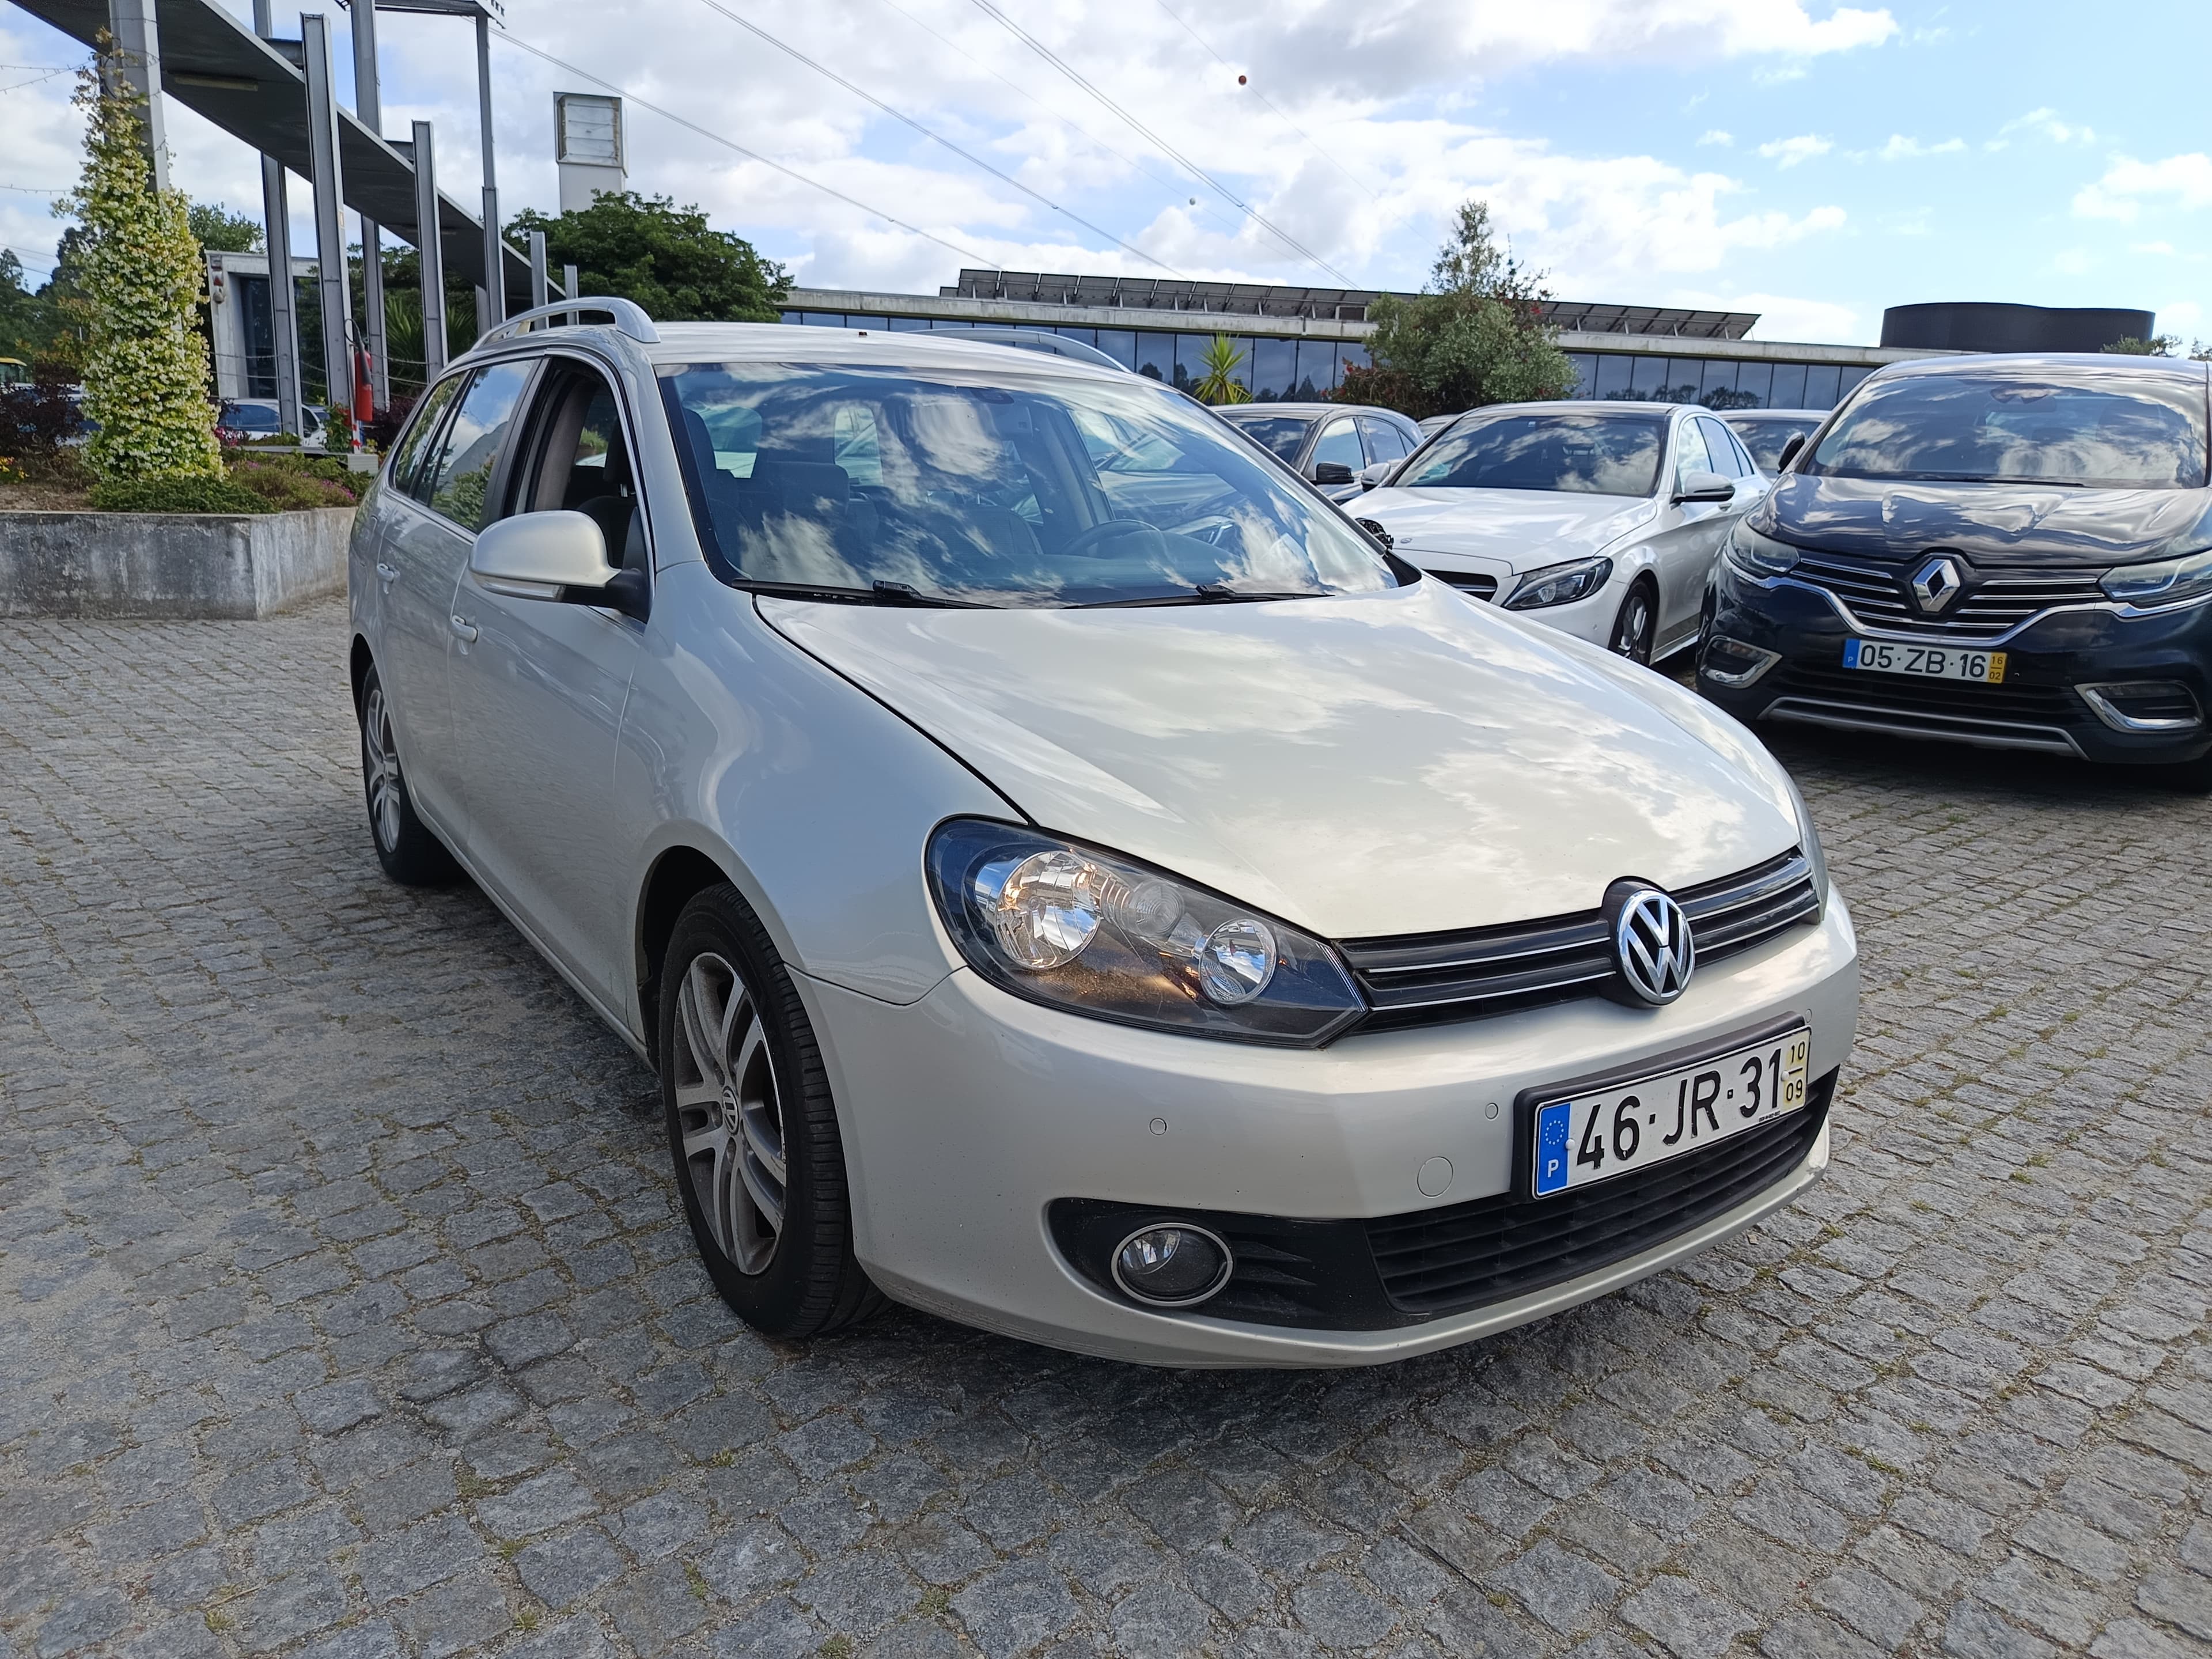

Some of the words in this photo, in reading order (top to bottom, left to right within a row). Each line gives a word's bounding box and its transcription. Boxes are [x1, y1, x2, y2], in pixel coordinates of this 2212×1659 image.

[1991, 656, 2003, 665] 16
[1989, 672, 2001, 680] 02
[1622, 892, 1691, 999] VW
[1790, 1041, 1806, 1063] 10
[1786, 1080, 1804, 1103] 09
[1547, 1159, 1559, 1179] P
